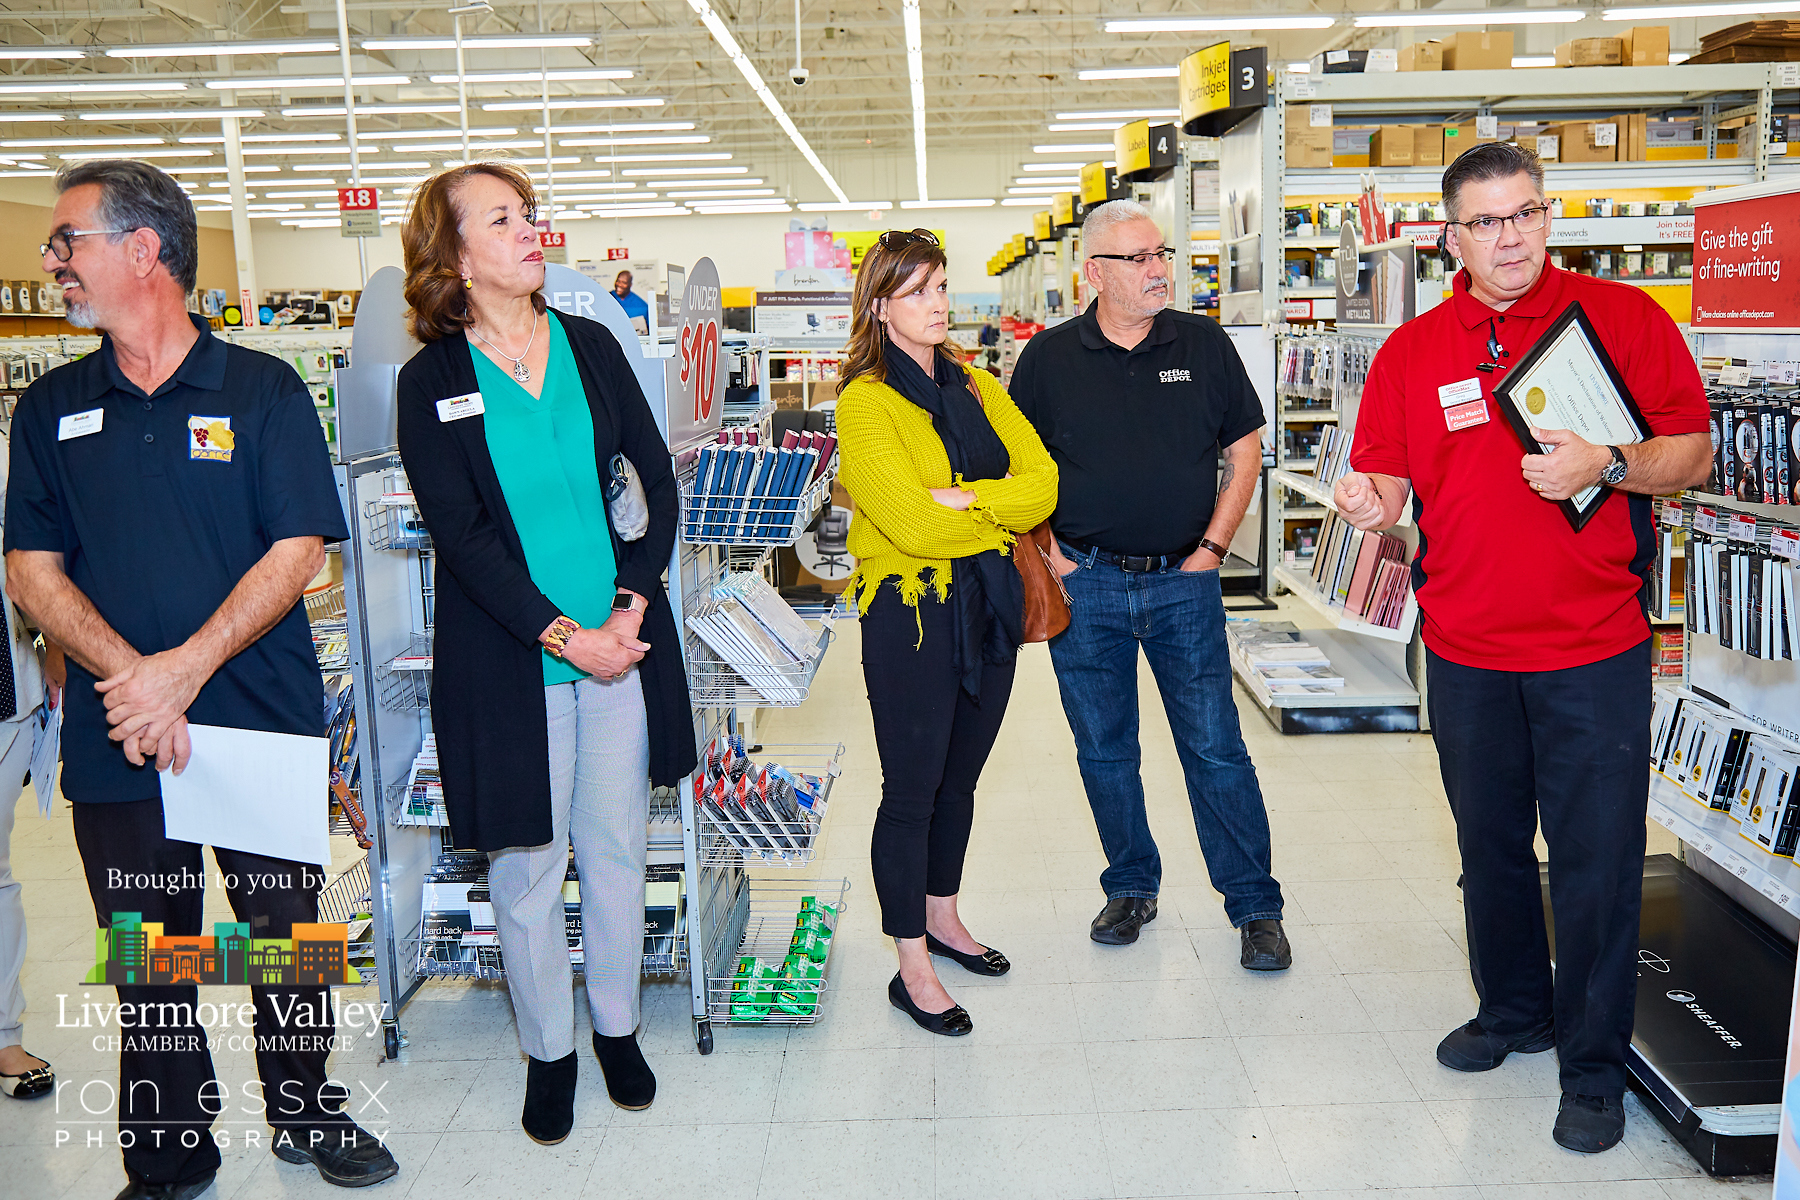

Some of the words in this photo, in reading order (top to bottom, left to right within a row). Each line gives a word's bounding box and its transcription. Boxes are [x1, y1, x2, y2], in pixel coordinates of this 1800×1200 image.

[1202, 59, 1227, 79] Inkjet
[1241, 66, 1255, 91] 3
[1189, 79, 1226, 101] Cartridges
[1128, 139, 1147, 152] Labels
[1157, 136, 1168, 154] 4
[1111, 175, 1120, 189] 5
[345, 190, 371, 206] 18
[1076, 203, 1083, 214] 6
[1656, 221, 1673, 229] Join
[1557, 228, 1589, 237] rewards
[1660, 231, 1671, 239] It's
[1700, 230, 1726, 251] Give
[1729, 226, 1748, 248] the
[1751, 222, 1774, 252] gift
[545, 233, 562, 246] 16
[611, 249, 626, 259] 15
[1700, 258, 1711, 279] of
[1714, 255, 1780, 282] fine-writing
[689, 284, 718, 311] UNDER
[1345, 309, 1371, 320] METALLICS
[680, 316, 719, 427] $10
[1159, 369, 1191, 378] Office
[1589, 374, 1609, 405] LIVERMORE
[1567, 359, 1581, 381] Mayor's
[1579, 380, 1597, 409] Declaration
[1600, 414, 1614, 439] Welcome
[1450, 414, 1465, 422] Price
[1466, 409, 1484, 418] Match
[1567, 394, 1580, 414] Office
[1578, 413, 1590, 432] Depot
[1453, 416, 1484, 428] Guarantee
[1663, 499, 1671, 507] SALE
[1696, 505, 1704, 513] SALE
[1731, 513, 1740, 521] SALE
[1771, 526, 1783, 536] SALE
[1752, 715, 1767, 728] FOR
[424, 927, 441, 935] hard
[443, 925, 462, 935] back
[1686, 1003, 1743, 1049] SHEAFFER
